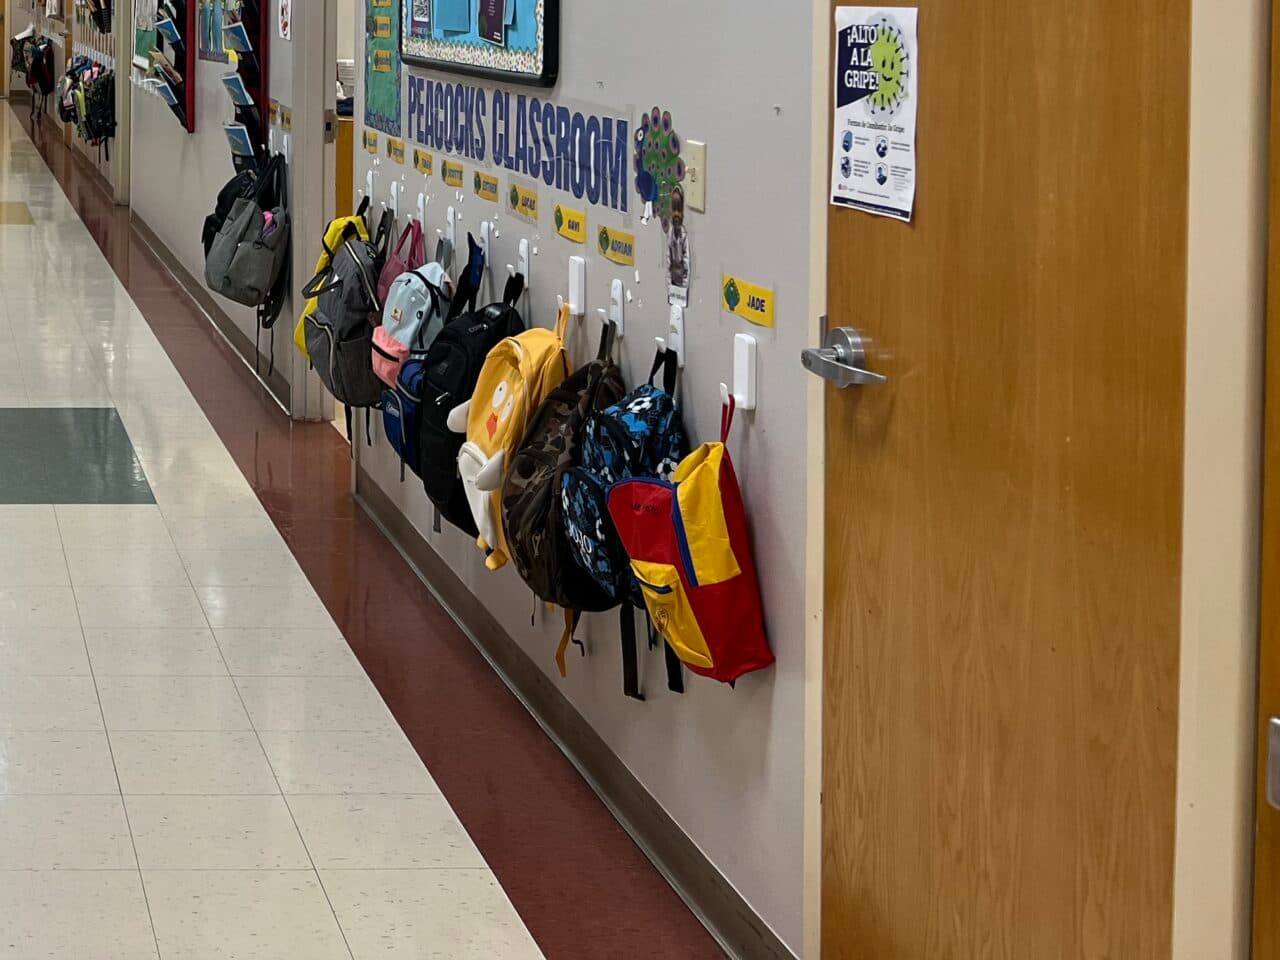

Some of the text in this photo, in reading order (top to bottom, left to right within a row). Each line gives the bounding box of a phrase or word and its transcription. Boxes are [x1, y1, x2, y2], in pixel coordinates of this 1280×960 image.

[847, 25, 877, 47] ¡ALTO
[844, 69, 879, 90] GRIPE!
[408, 74, 628, 213] PEACOCKS CLASSROOM
[747, 294, 766, 313] JADE
